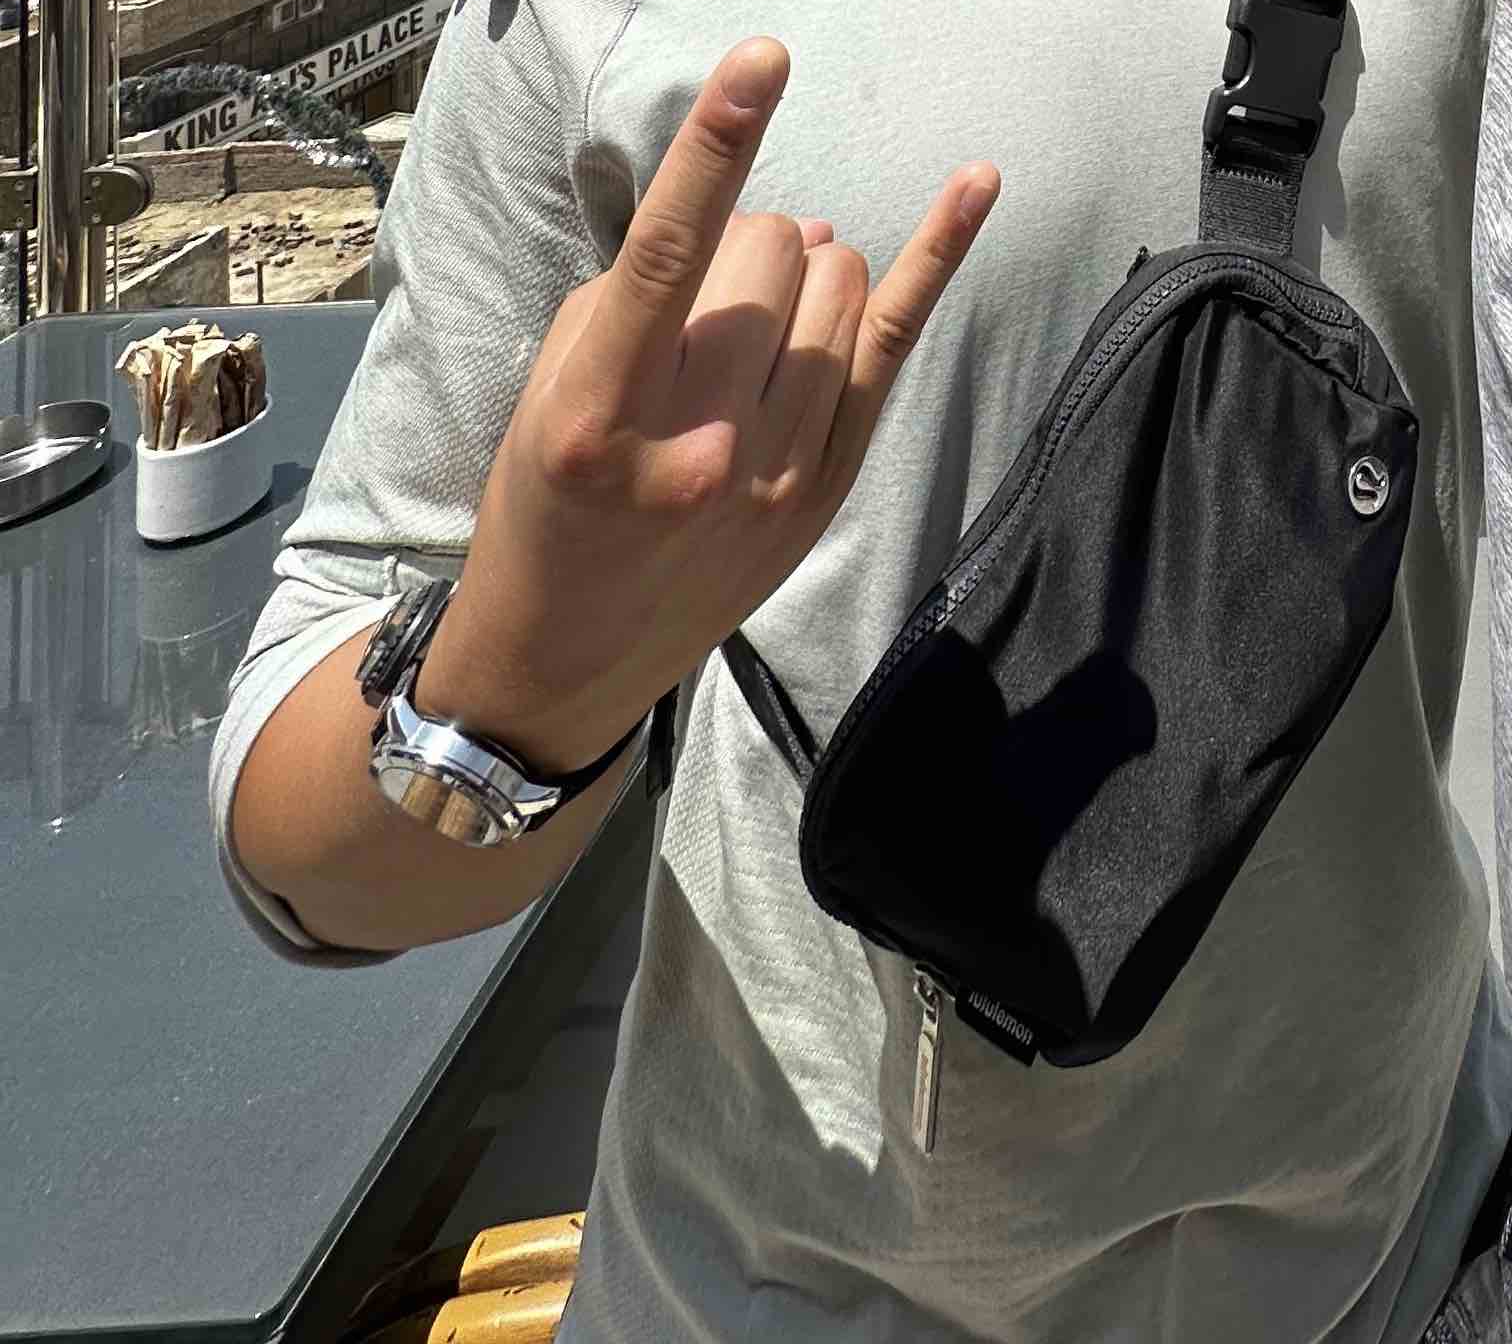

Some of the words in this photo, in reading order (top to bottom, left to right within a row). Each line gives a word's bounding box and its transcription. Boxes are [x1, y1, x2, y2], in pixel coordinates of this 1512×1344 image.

[163, 99, 238, 152] KING
[327, 6, 425, 78] PALACE
[968, 991, 1034, 1046] lululemon
